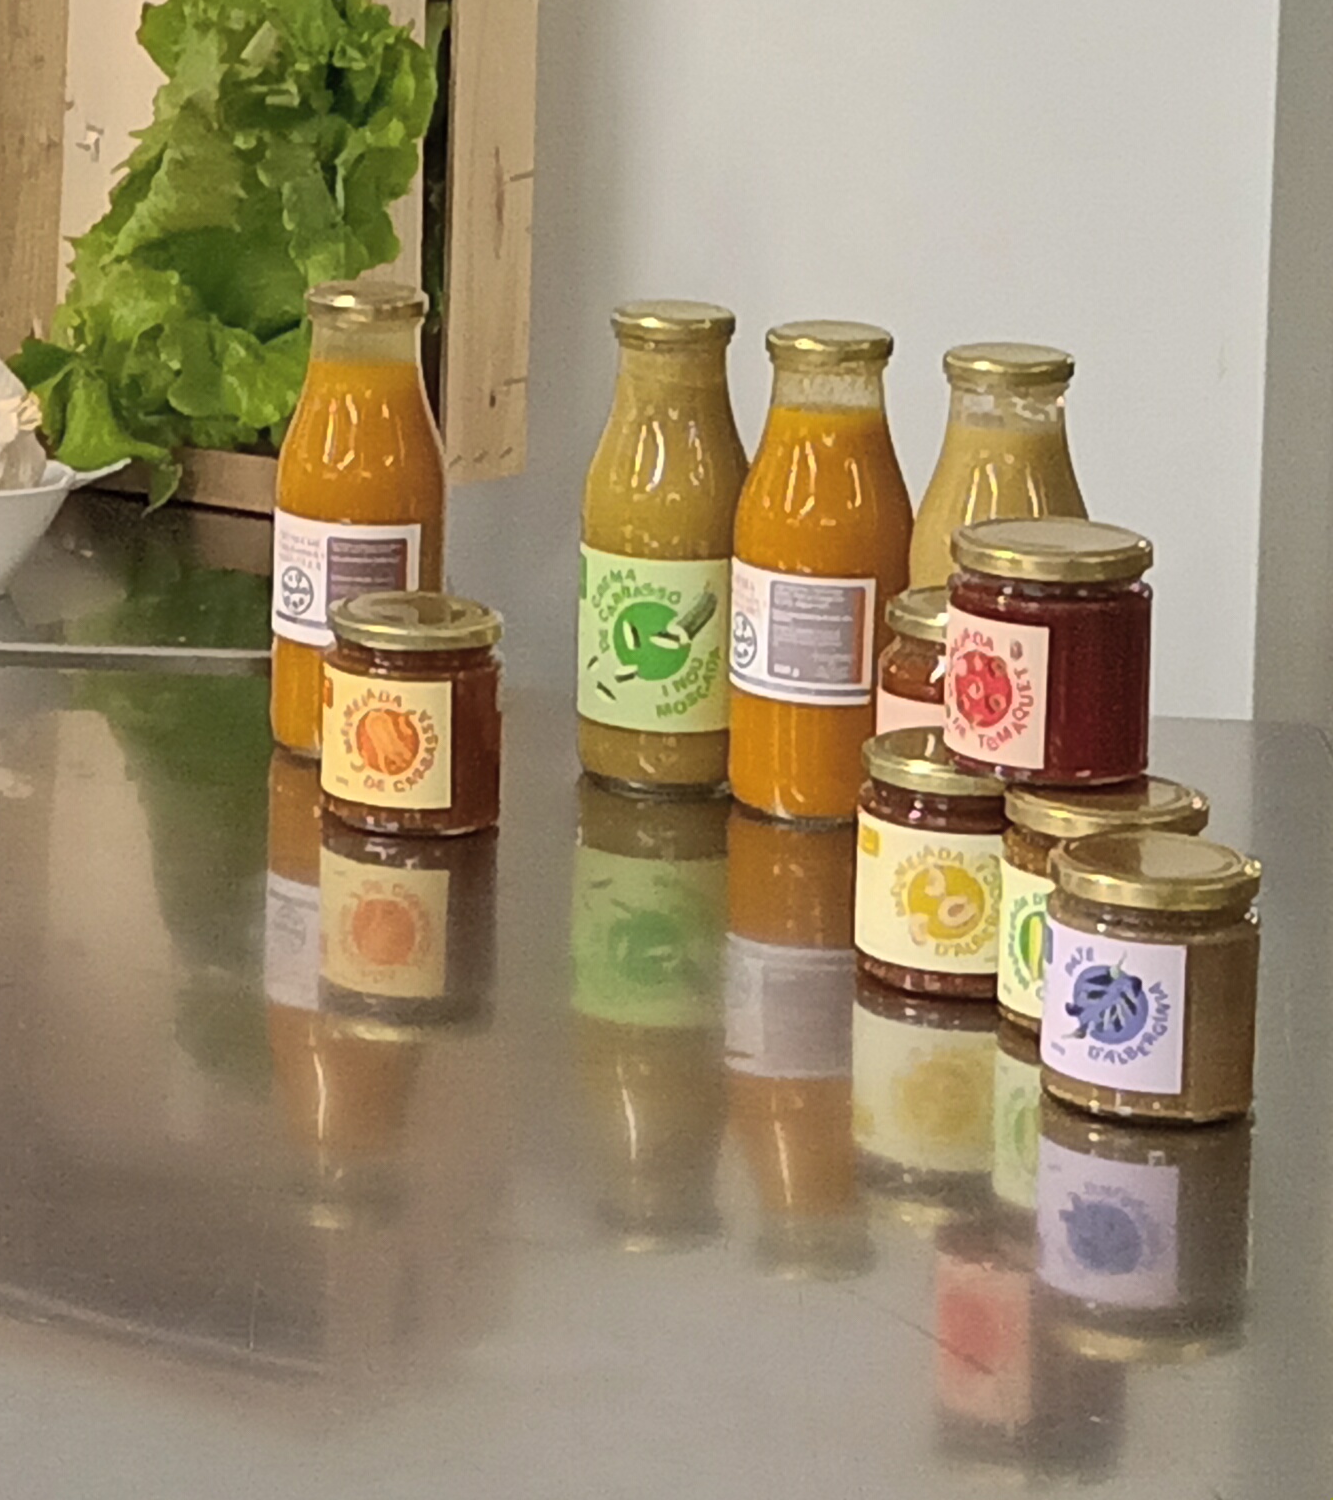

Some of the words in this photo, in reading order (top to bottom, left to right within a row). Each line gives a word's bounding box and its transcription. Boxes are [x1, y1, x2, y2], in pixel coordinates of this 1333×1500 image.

[591, 568, 636, 609] CREMA
[655, 646, 721, 719] MOSCADA
[672, 657, 704, 693] NOU
